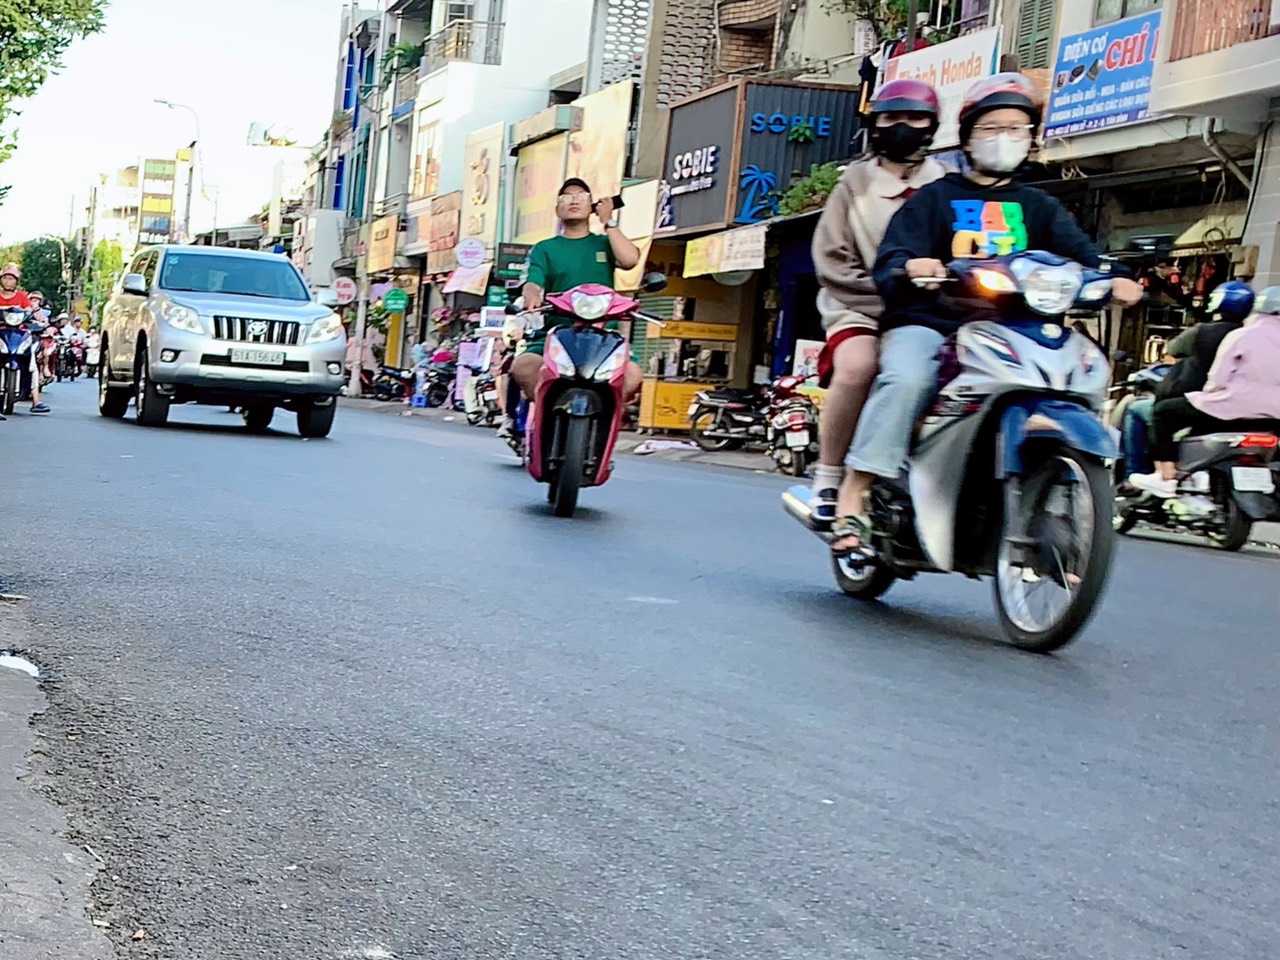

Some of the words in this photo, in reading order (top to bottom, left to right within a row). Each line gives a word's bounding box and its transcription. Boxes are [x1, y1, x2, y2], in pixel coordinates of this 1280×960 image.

[1105, 22, 1150, 71] CHÍ
[941, 51, 983, 86] Honda
[751, 112, 832, 137] SOBIE
[673, 145, 717, 181] SOBIE
